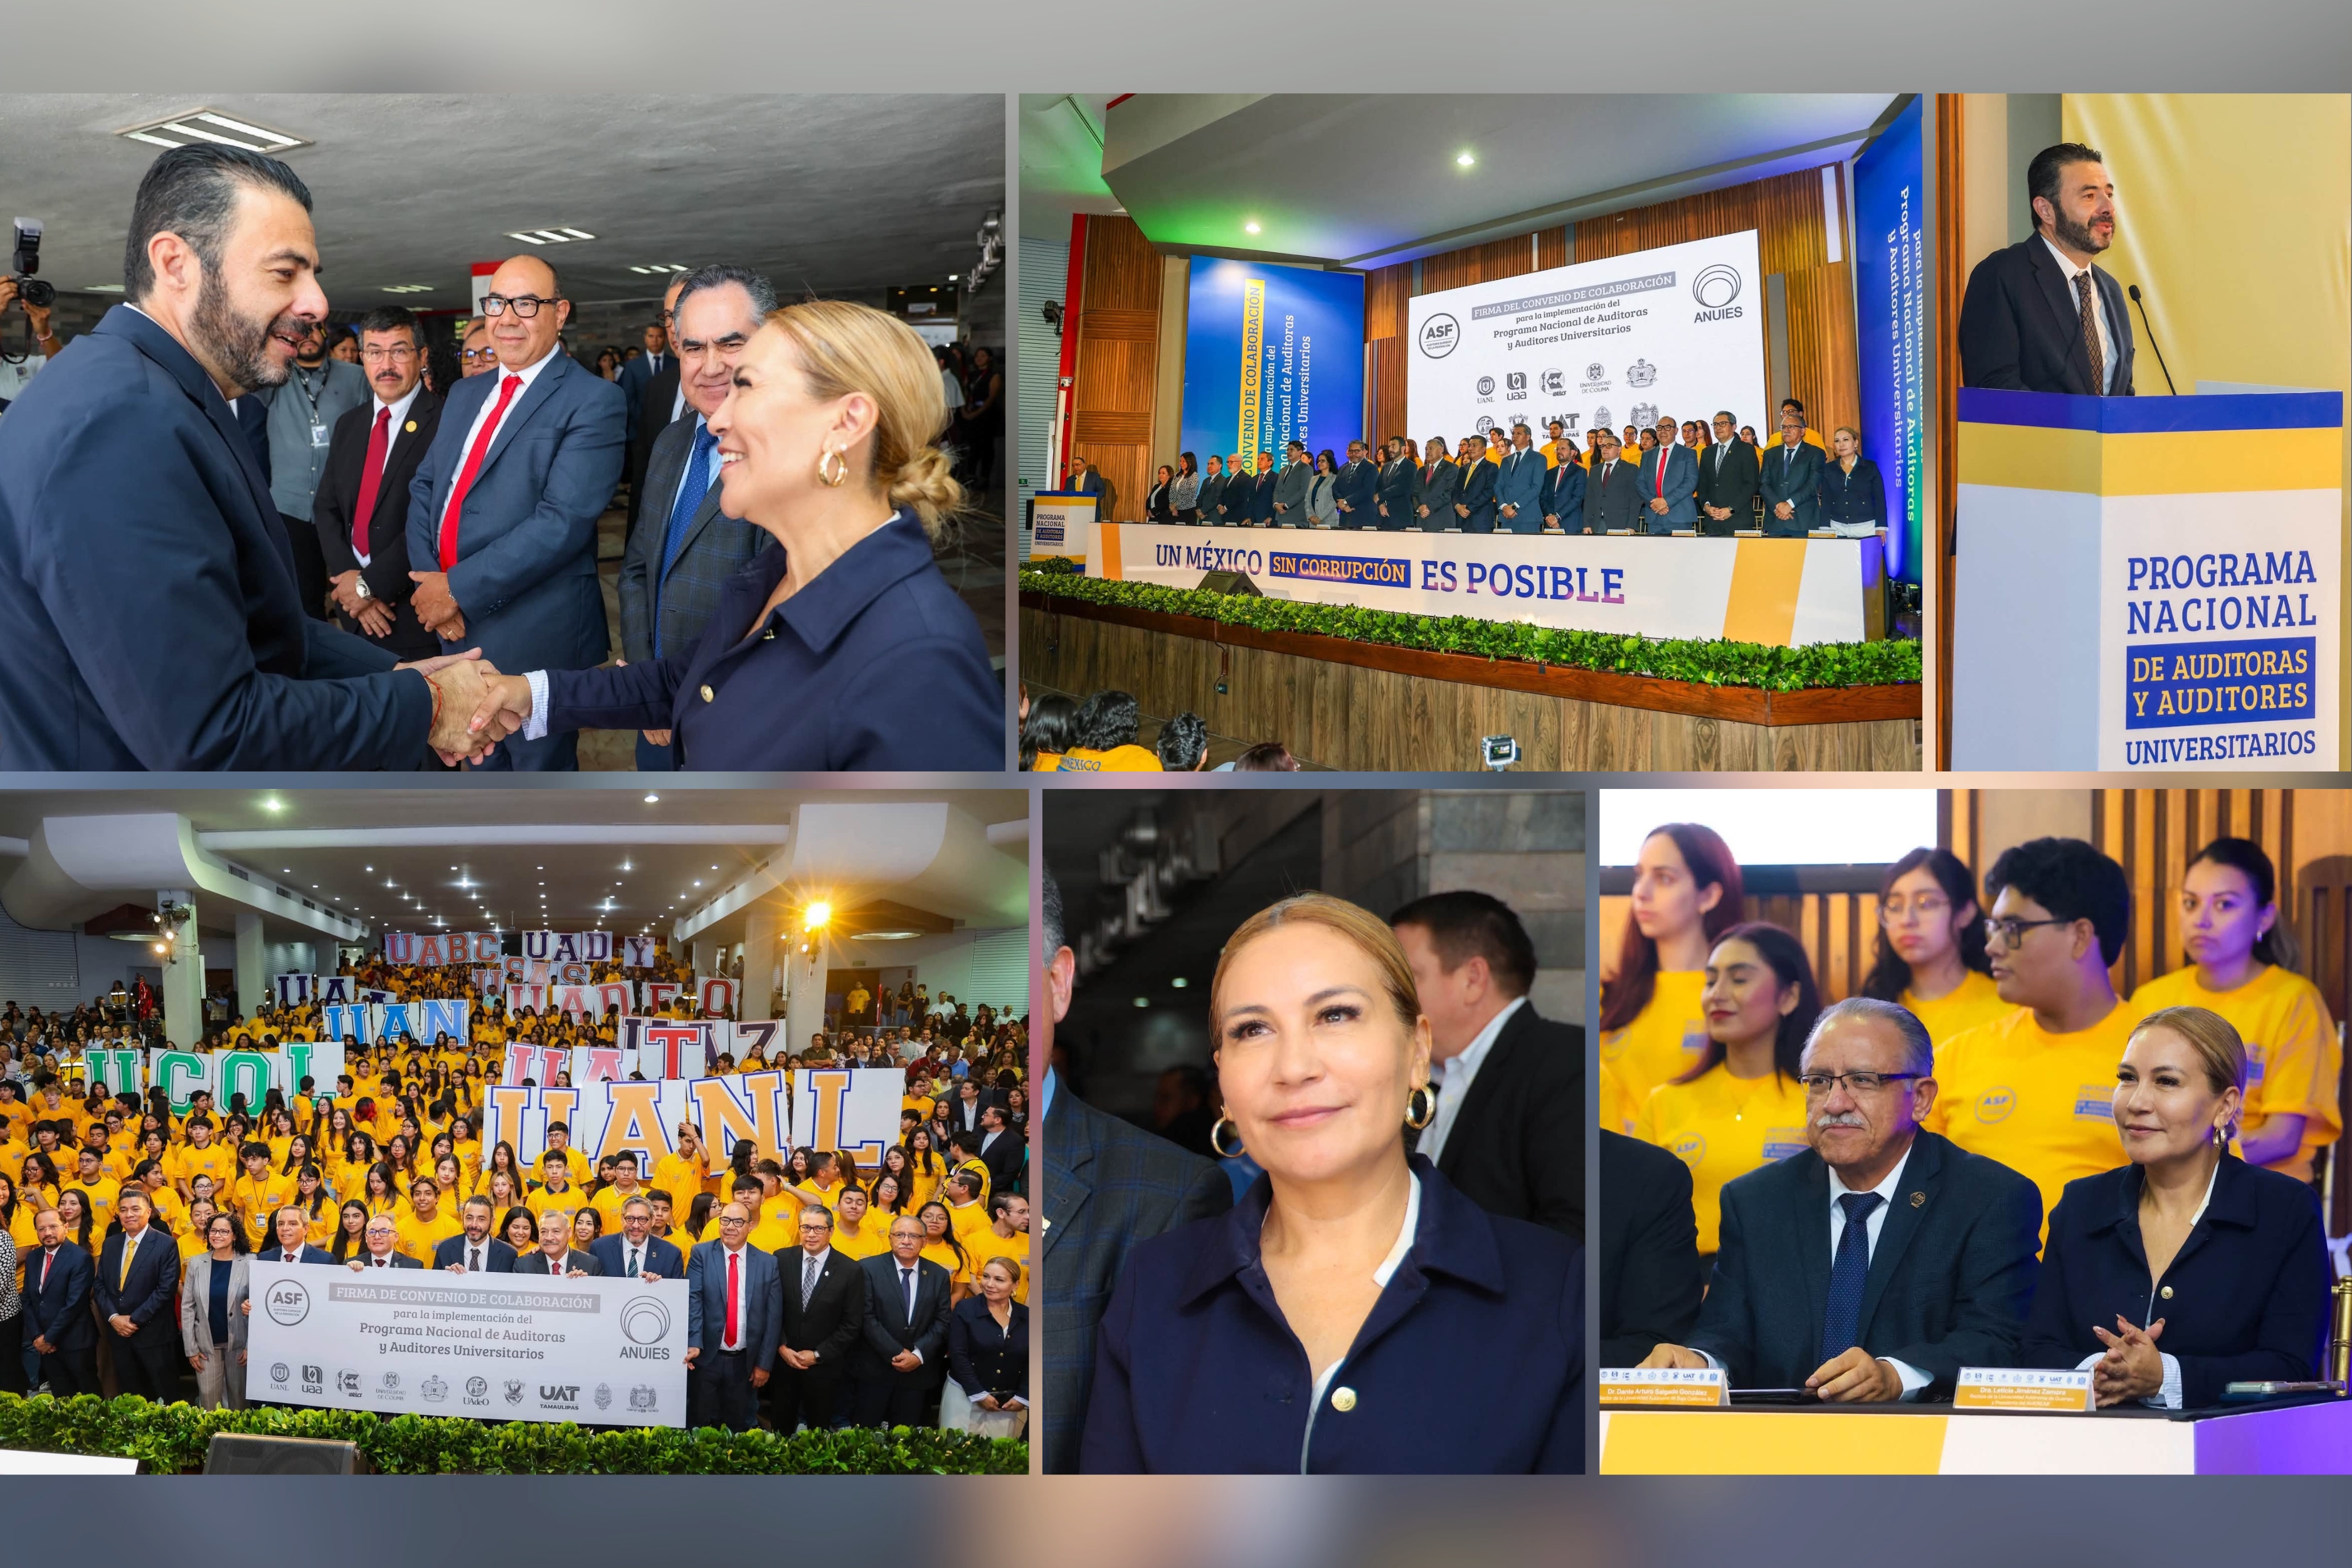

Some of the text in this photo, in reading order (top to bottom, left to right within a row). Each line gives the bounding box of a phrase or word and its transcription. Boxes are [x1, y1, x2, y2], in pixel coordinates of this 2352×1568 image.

[1914, 228, 1922, 272] para
[1474, 275, 1673, 317] FIRMA DEL CONVENIO DE COLABORACIÓN
[1493, 308, 1648, 338] Programa Nacional de Auditoras
[1516, 315, 1534, 324] para
[1544, 301, 1606, 320] implementación
[1608, 299, 1620, 308] del
[1694, 306, 1743, 323] ANUIES
[1245, 287, 1260, 387] COLABORACIÓN
[1281, 315, 1294, 375] Auditoras
[1426, 324, 1453, 339] ASF
[1507, 324, 1631, 351] y Auditores Universitarios
[1266, 346, 1276, 361] del
[1888, 229, 1904, 488] y Auditores Universitarios
[1900, 186, 1916, 521] Programa Nacional de Auditoras
[1281, 377, 1292, 391] de
[1298, 336, 1311, 423] Universitarios
[1579, 380, 1612, 388] UNIVERSIDAD
[1245, 389, 1256, 406] DE
[1263, 363, 1276, 444] implementación
[1279, 394, 1291, 450] Nacional
[1157, 540, 1625, 604] UN MÉXICO SIN CORRUPCIÓN ES POSIBLE
[2127, 551, 2317, 591] PROGRAMA
[2127, 593, 2317, 635] NACIONAL
[2133, 649, 2307, 682] DE AUDITORAS
[2133, 683, 2307, 717] Y AUDITORES
[2126, 731, 2316, 765] UNIVERSITARIOS
[1983, 1096, 2010, 1106] ASF
[490, 1069, 886, 1179] UANL
[273, 1291, 302, 1305] ASF
[337, 1287, 593, 1309] FIRMA DE CONVENIO DE COLABORACIÓN
[393, 1310, 532, 1324] para la implementación del
[359, 1323, 565, 1343] Programa Nacional de Auditoras
[379, 1342, 544, 1359] y Auditores Universitarios
[619, 1347, 670, 1360] ANUIES
[302, 1385, 322, 1394] uaa
[462, 1397, 490, 1406] UAdeO
[539, 1385, 580, 1402] UAT
